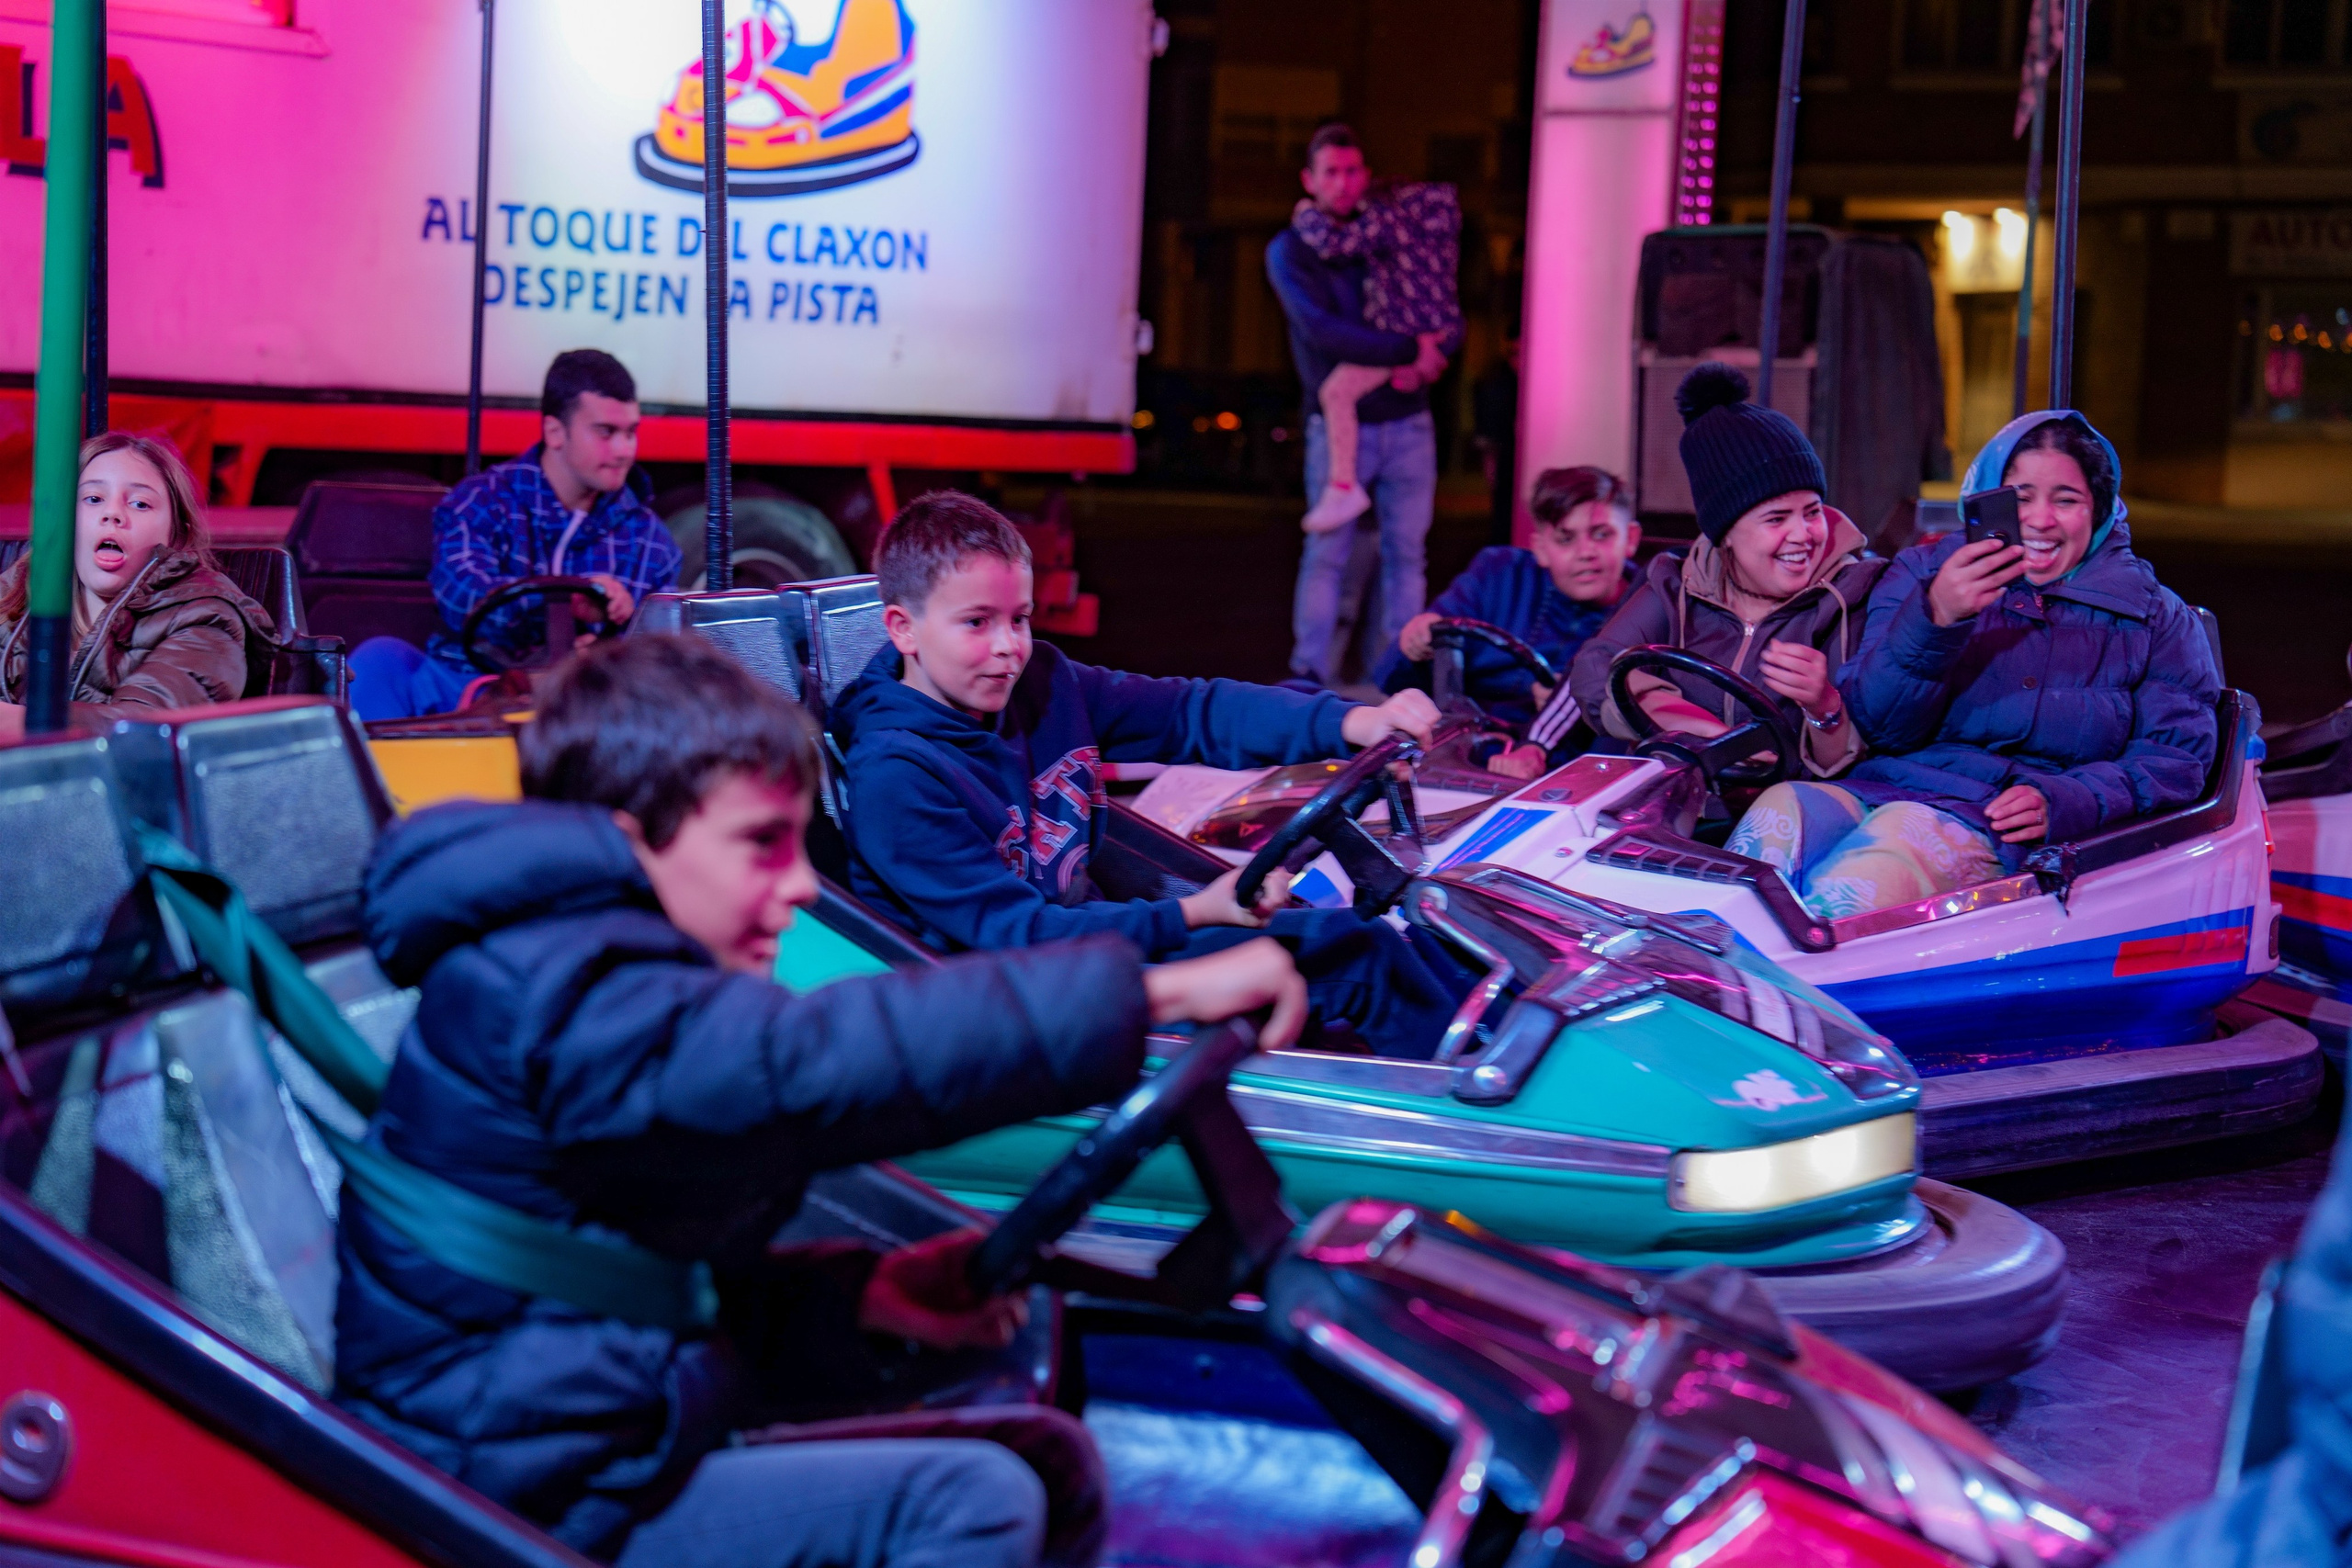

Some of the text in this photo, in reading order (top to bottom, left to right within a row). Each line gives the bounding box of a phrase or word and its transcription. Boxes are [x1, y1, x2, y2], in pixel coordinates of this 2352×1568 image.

[421, 197, 927, 271] AL TOQUE DL CLAXON
[484, 264, 687, 322] DESPEJEN
[769, 282, 878, 325] PISTA
